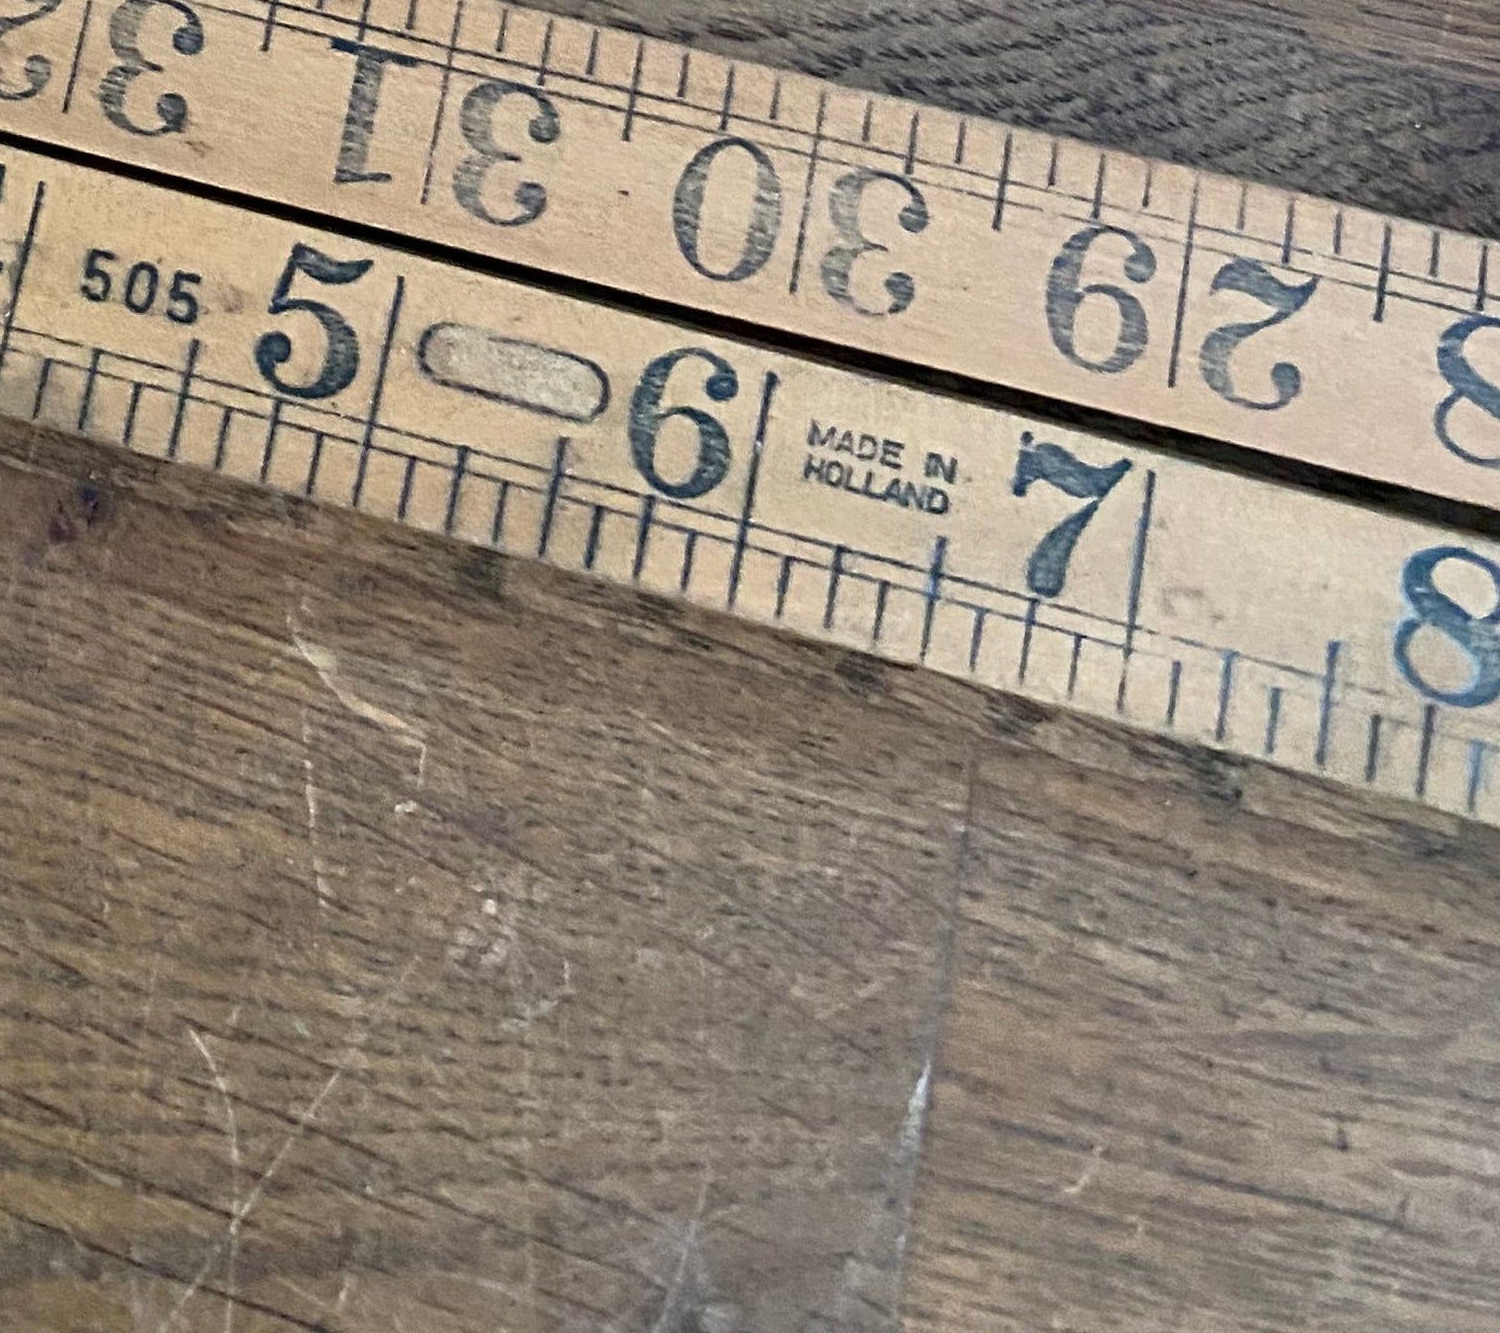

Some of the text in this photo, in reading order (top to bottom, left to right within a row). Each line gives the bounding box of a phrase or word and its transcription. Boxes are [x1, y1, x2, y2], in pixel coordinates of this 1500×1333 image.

[330, 36, 561, 228] 31
[79, 248, 202, 326] 505
[672, 134, 930, 318] 30
[1043, 223, 1321, 412] 29
[253, 241, 375, 400] 5
[627, 346, 740, 500] 6
[1010, 431, 1133, 600] 7
[1393, 544, 1500, 710] 8
[802, 450, 950, 515] HOLLAND
[807, 419, 957, 485] MADE IN
